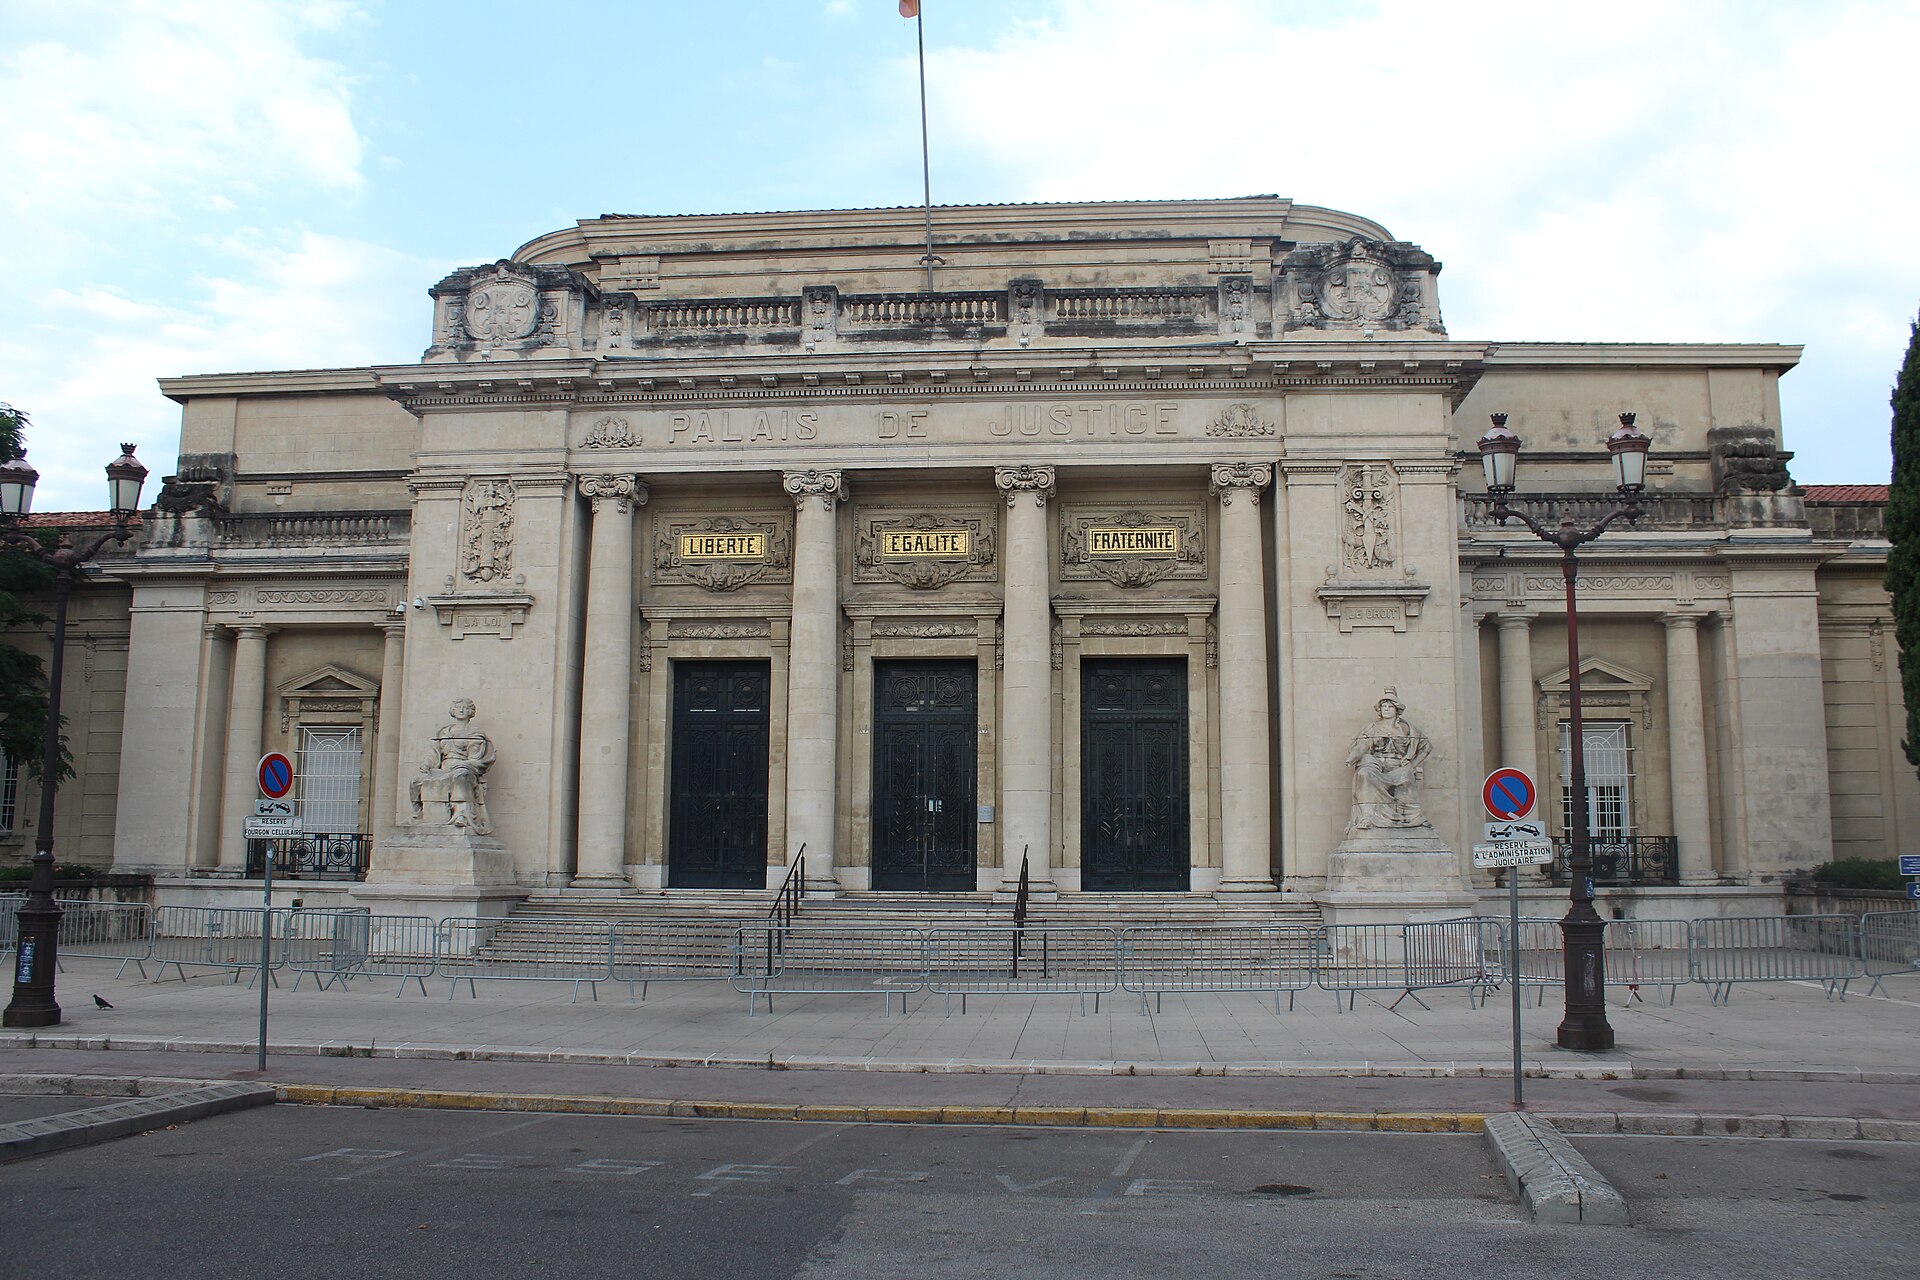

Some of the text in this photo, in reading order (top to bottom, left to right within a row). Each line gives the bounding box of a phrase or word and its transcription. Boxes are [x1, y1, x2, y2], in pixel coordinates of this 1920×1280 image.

[668, 403, 1179, 444] PALAIS DE JUSTICE
[1348, 608, 1398, 620] LE DROIT
[463, 616, 502, 628] LA LOI
[244, 828, 303, 836] FOURGON CELLULAIRE
[1482, 847, 1551, 860] L'ADMINISTRATION
[1493, 856, 1535, 867] JUDICIAIRE
